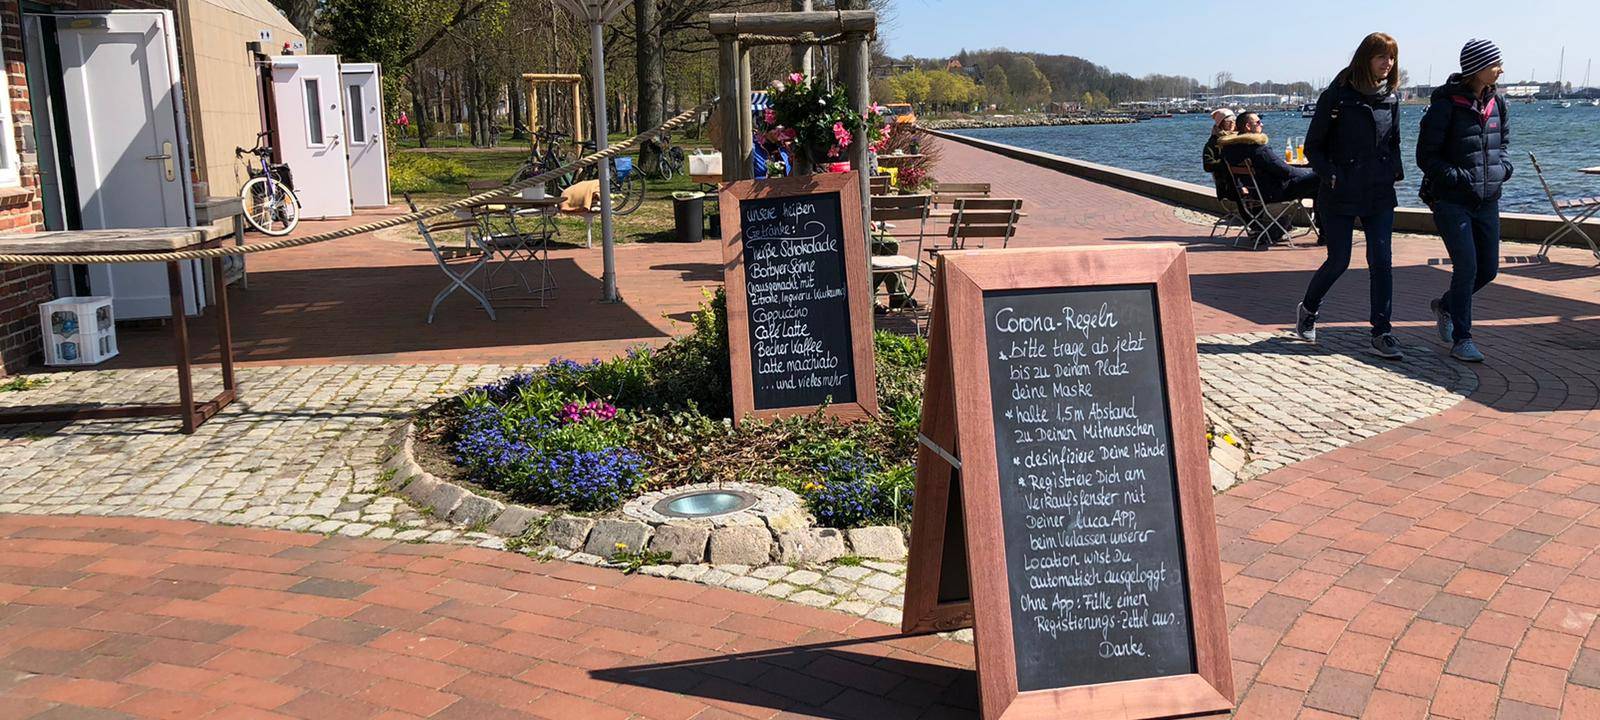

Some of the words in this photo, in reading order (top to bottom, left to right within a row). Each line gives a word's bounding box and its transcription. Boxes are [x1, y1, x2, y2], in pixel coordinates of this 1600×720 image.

[747, 207, 777, 222] unsere
[782, 202, 815, 224] heißen
[780, 234, 838, 257] Schokolade
[749, 262, 789, 280] Borbyer
[800, 274, 815, 288] mit
[752, 306, 808, 325] Cappuccino
[995, 302, 1119, 339] Corona-Regeln
[755, 323, 780, 342] Café
[782, 321, 811, 337] Latte
[754, 340, 788, 357] Becher
[791, 337, 823, 356] Kaffee
[1009, 337, 1047, 358] bitte
[1053, 339, 1087, 364] trage
[1091, 336, 1109, 355] ab
[1113, 331, 1147, 363] jetzt
[758, 358, 785, 374] Latte
[787, 351, 838, 371] macchiato
[1010, 365, 1031, 380] bis
[1034, 366, 1050, 379] zu
[1054, 363, 1091, 378] Deinem
[1095, 359, 1129, 376] Platz
[1011, 383, 1048, 400] deine
[1052, 379, 1093, 398] Maske
[1016, 405, 1049, 424] halte
[1089, 395, 1137, 420] Abstand
[1014, 430, 1033, 443] zu
[1036, 426, 1076, 442] Deinen
[1083, 419, 1155, 439] Mitmenschen
[1024, 446, 1096, 470] desinfiziere
[1100, 445, 1130, 461] Deine
[1134, 438, 1166, 458] Hände
[1028, 467, 1093, 495] Registriere
[1095, 465, 1121, 484] Dich
[1124, 468, 1146, 481] am
[1025, 485, 1120, 515] Verkaufsfenster
[1124, 484, 1146, 504] mit
[1025, 514, 1065, 529] Deiner
[1029, 534, 1057, 551] beim
[1057, 531, 1107, 549] Verlassen
[1110, 530, 1155, 544] unserer
[1024, 551, 1080, 571] Location
[1113, 549, 1132, 563] Du
[1029, 568, 1101, 589] automatisch
[1104, 562, 1166, 592] ausgeloggt
[1021, 593, 1048, 612] Ohne
[1083, 591, 1113, 610] Fülle
[1117, 591, 1149, 608] einen
